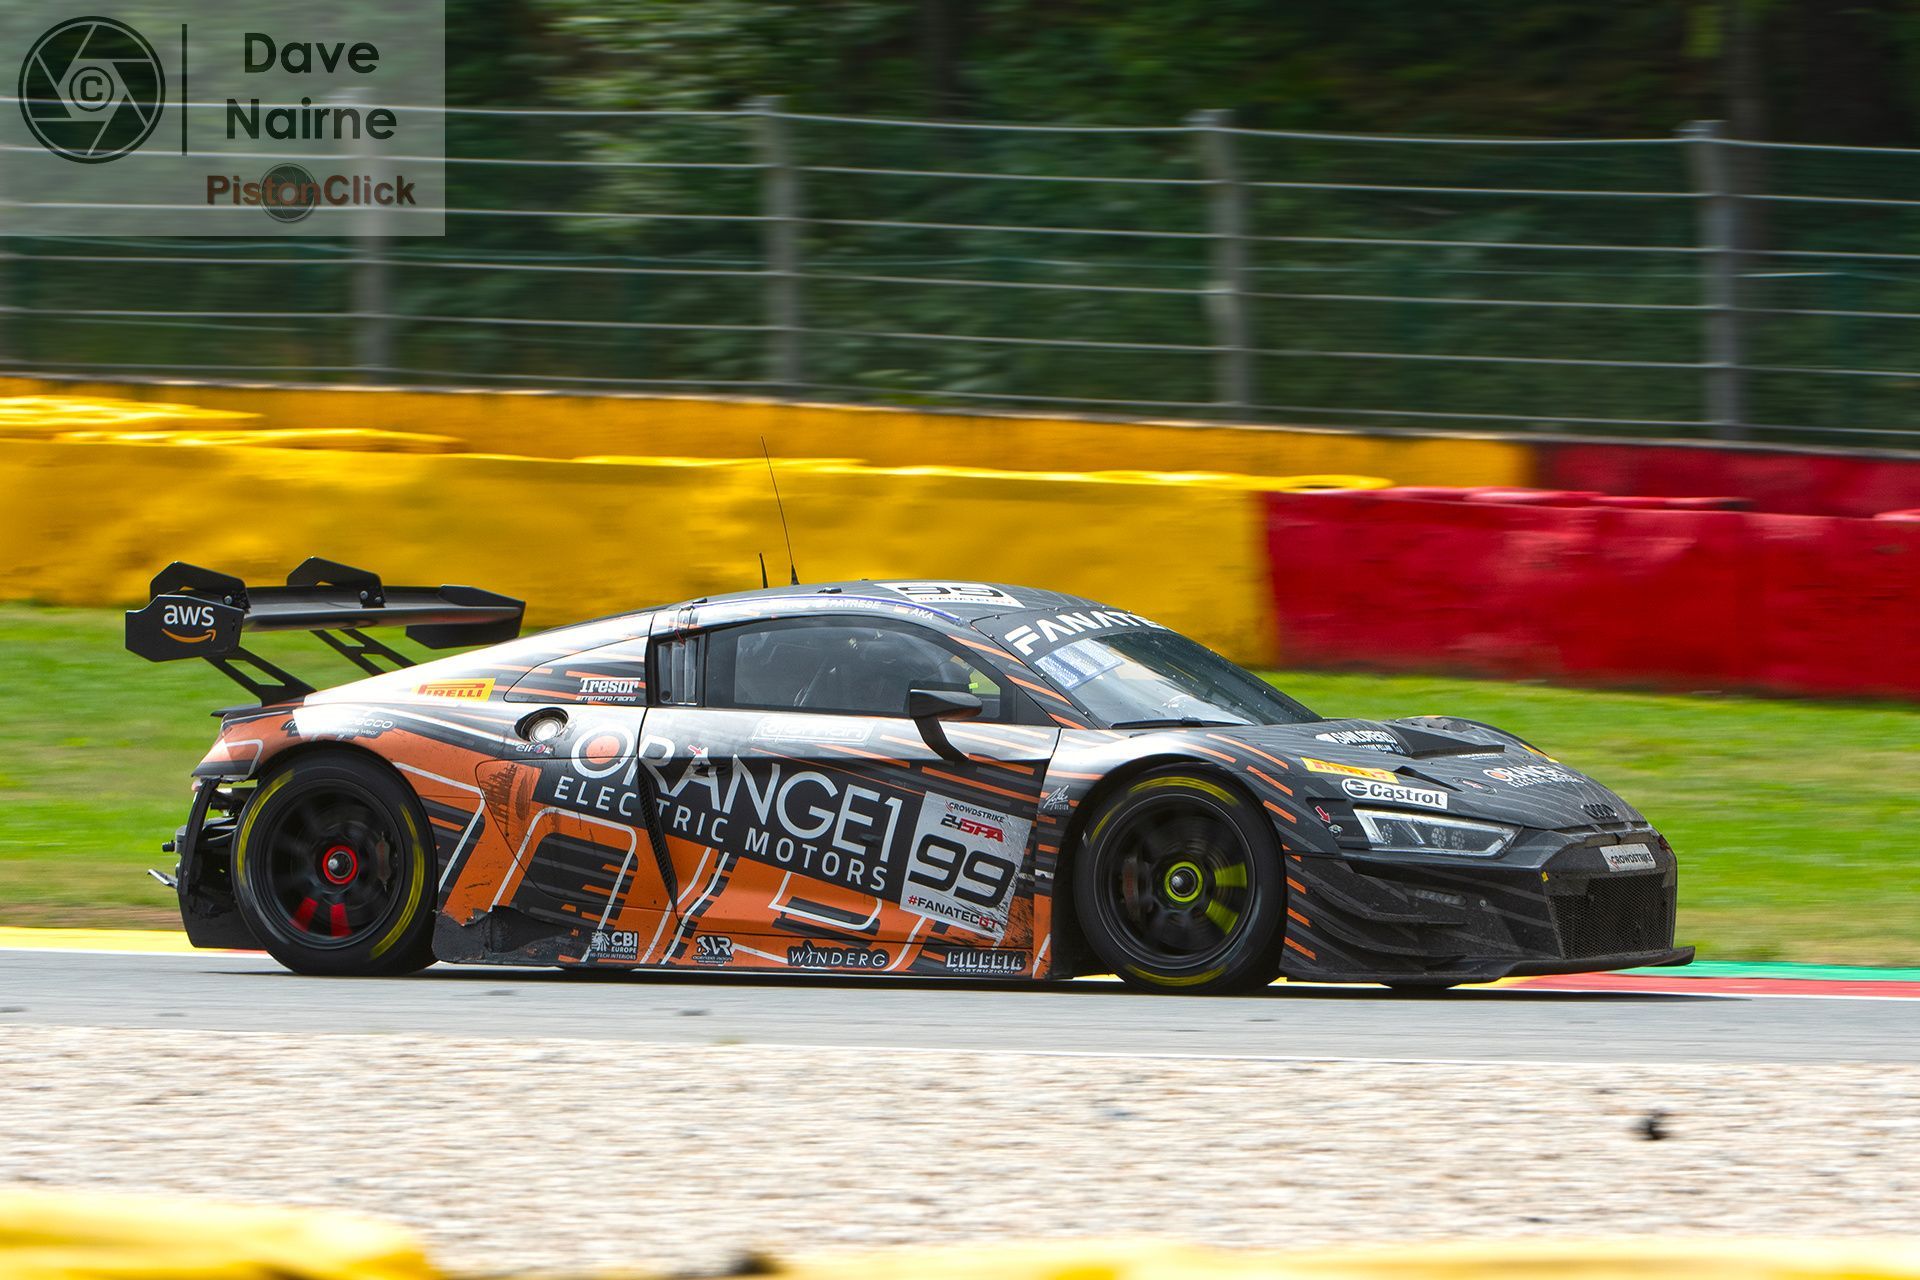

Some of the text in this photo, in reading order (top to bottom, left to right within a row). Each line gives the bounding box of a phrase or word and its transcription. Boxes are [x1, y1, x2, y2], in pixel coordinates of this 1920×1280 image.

[164, 604, 215, 627] aws
[909, 607, 935, 620] AKA
[417, 683, 486, 698] PIRELLI
[579, 677, 641, 694] Tresor
[570, 724, 903, 864] ORANGE1
[1369, 783, 1443, 806] Castrol
[948, 801, 1005, 823] CROWDSTRIKE
[554, 775, 888, 892] ELECTRIC MOTORS
[907, 833, 1016, 909] 99
[611, 931, 638, 947] CBI
[611, 946, 637, 954] EUROPE
[790, 946, 887, 967] WINDERG
